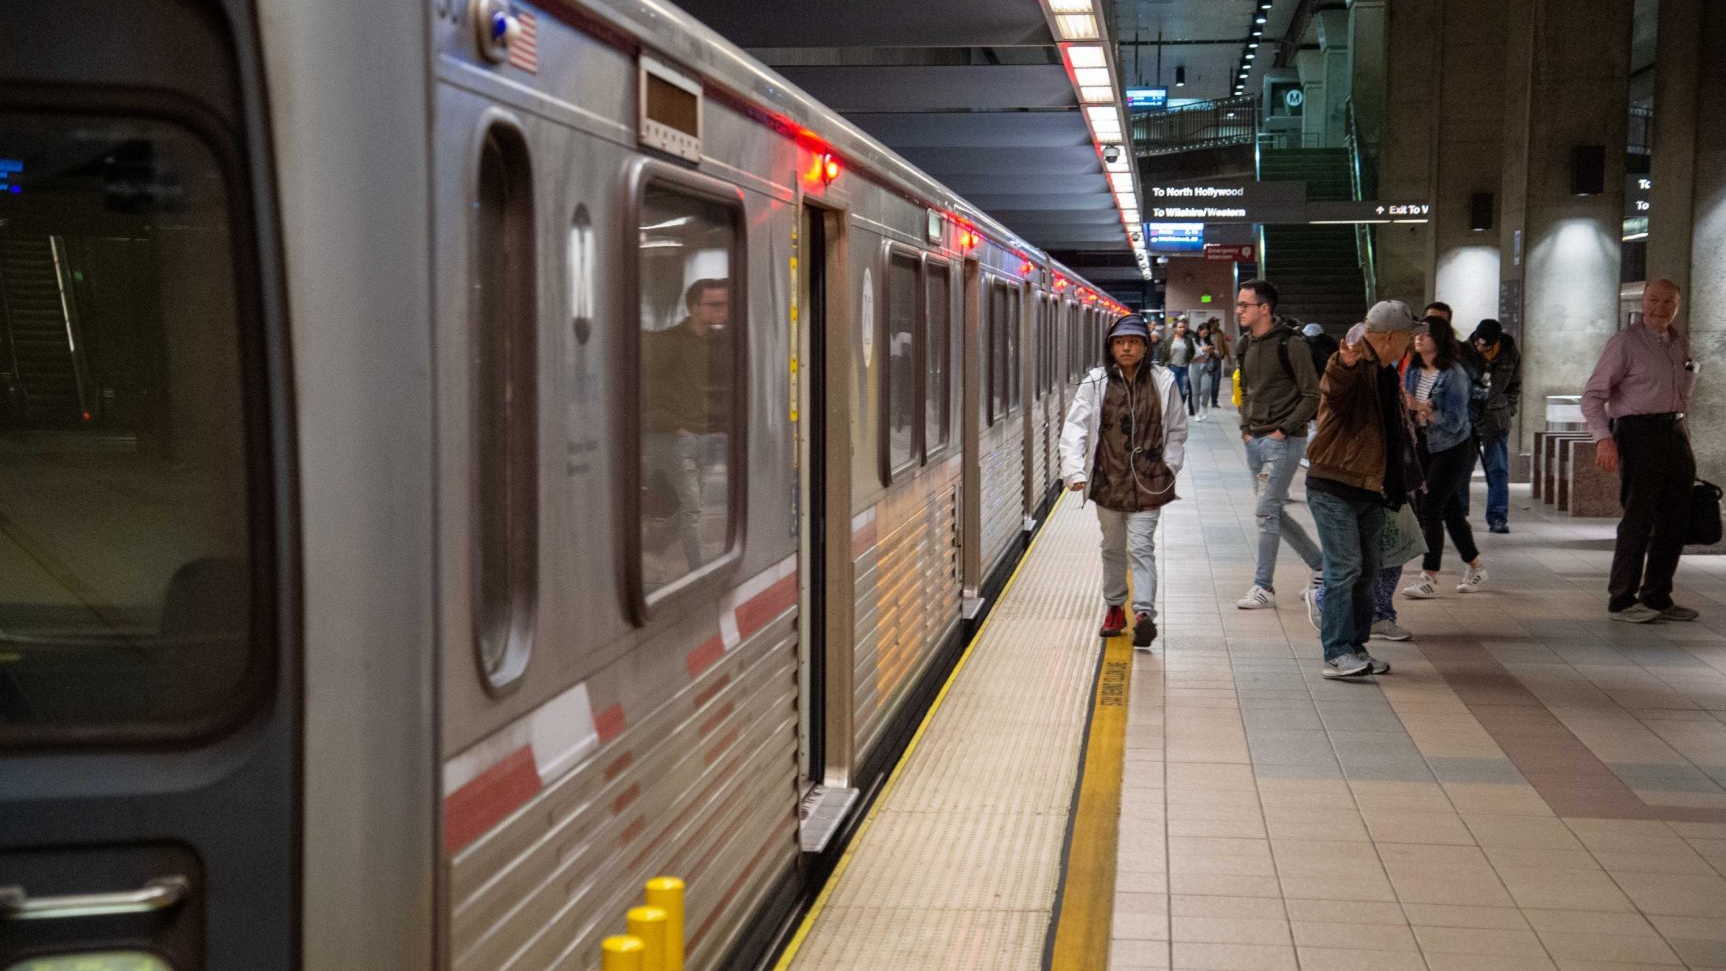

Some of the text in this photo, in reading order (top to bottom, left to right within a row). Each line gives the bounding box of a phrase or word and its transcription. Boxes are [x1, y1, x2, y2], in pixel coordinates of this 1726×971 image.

[1152, 187, 1244, 198] To North Hollywood
[1389, 205, 1408, 215] Exit
[1408, 205, 1421, 215] To
[1636, 200, 1650, 211] To
[1152, 207, 1246, 218] To Wilshire/Western
